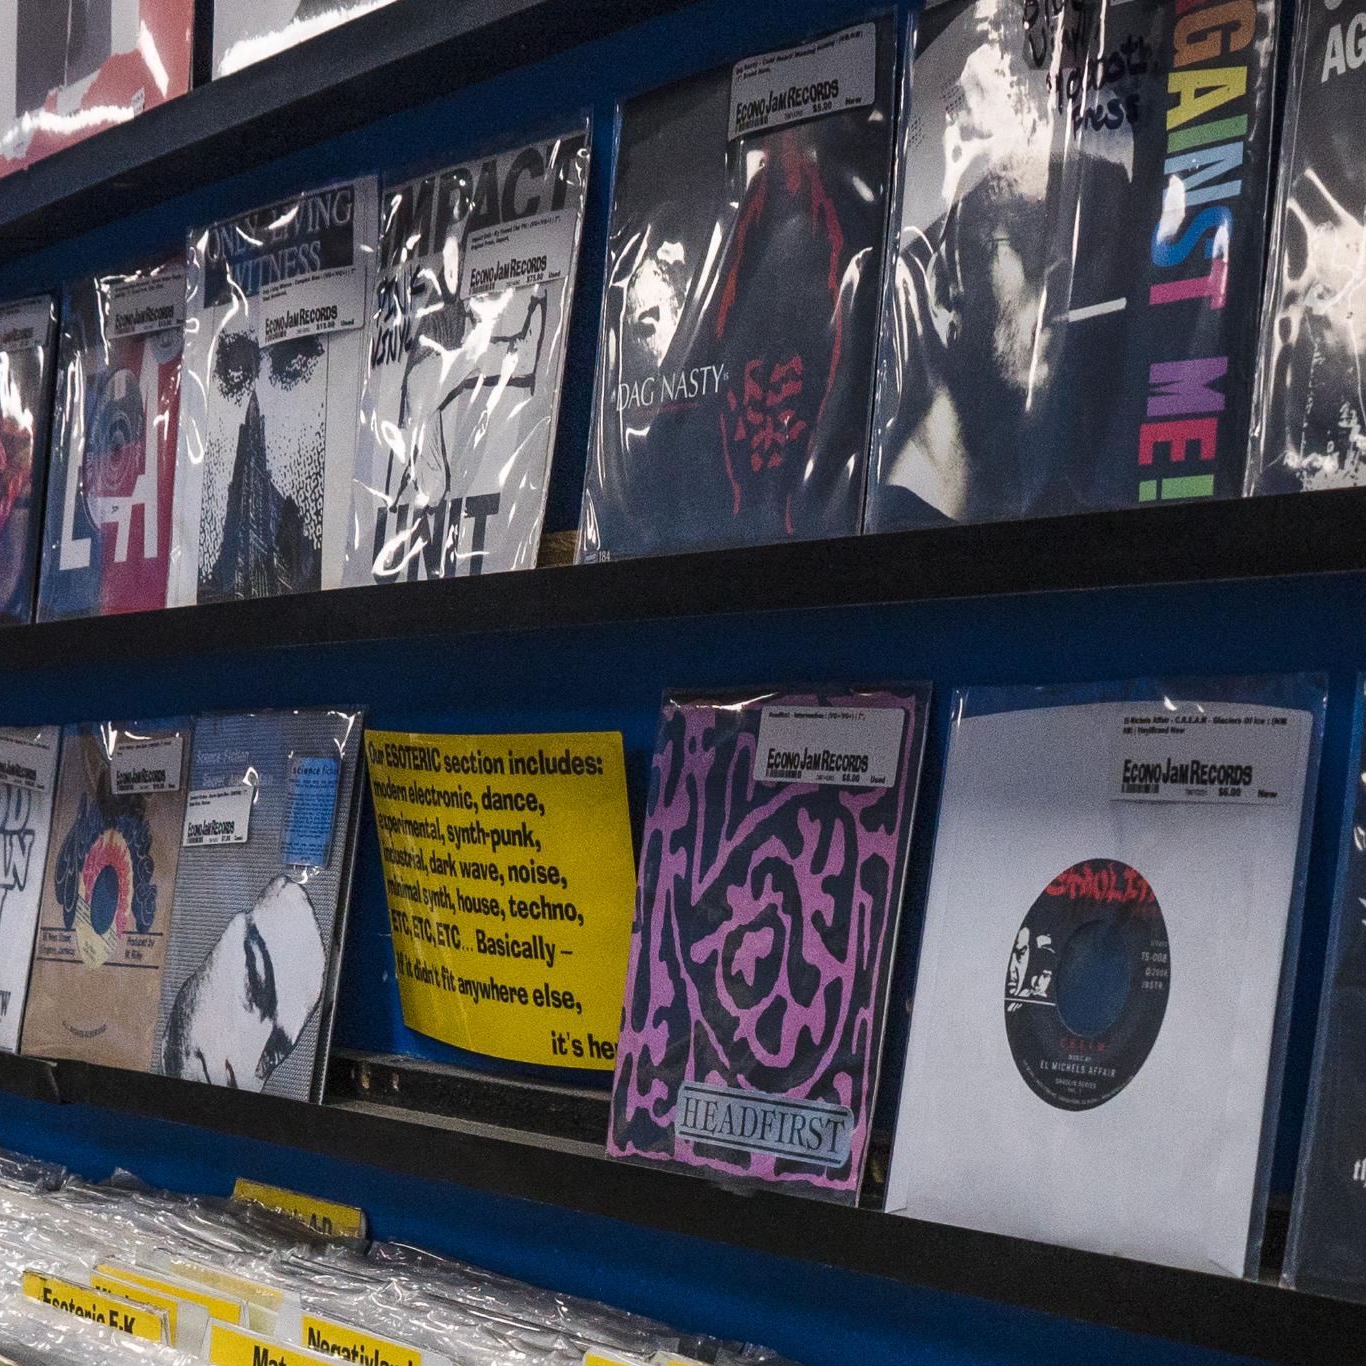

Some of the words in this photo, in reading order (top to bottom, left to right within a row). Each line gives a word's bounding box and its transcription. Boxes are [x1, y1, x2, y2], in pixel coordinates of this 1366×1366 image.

[1145, 0, 1257, 311] GAINST
[617, 378, 655, 411] DAG
[661, 363, 725, 402] NASTY
[1138, 356, 1229, 502] ME!
[373, 492, 501, 588] UNIT
[369, 744, 384, 765] Our
[385, 744, 441, 773] ESOTERIC
[444, 750, 504, 775] section
[509, 750, 603, 776] includes:
[373, 778, 407, 802] modern
[408, 780, 479, 814] electronic,
[481, 785, 545, 816] dance,
[1257, 789, 1278, 799] New
[378, 811, 445, 846] experimental,
[446, 819, 541, 853] synth-punk,
[384, 845, 428, 876] industrial,
[429, 851, 457, 878] dark
[460, 860, 504, 886] wave,
[508, 859, 568, 889] noise,
[387, 876, 420, 904] minimal
[422, 883, 455, 915] synth,
[457, 888, 506, 922] house,
[509, 894, 584, 927] techno,
[477, 928, 556, 968] Basically
[414, 960, 439, 989] didn't
[441, 965, 457, 993] fit
[458, 973, 528, 1006] anywhere
[532, 982, 583, 1015] else,
[551, 1030, 582, 1058] it's
[588, 1033, 617, 1061] he
[1040, 1060, 1049, 1070] EL
[1050, 1061, 1086, 1074] MICHELS
[1088, 1065, 1117, 1079] AFFAIR
[679, 1096, 847, 1157] HEADFIRST
[41, 1286, 107, 1325] Esoteric
